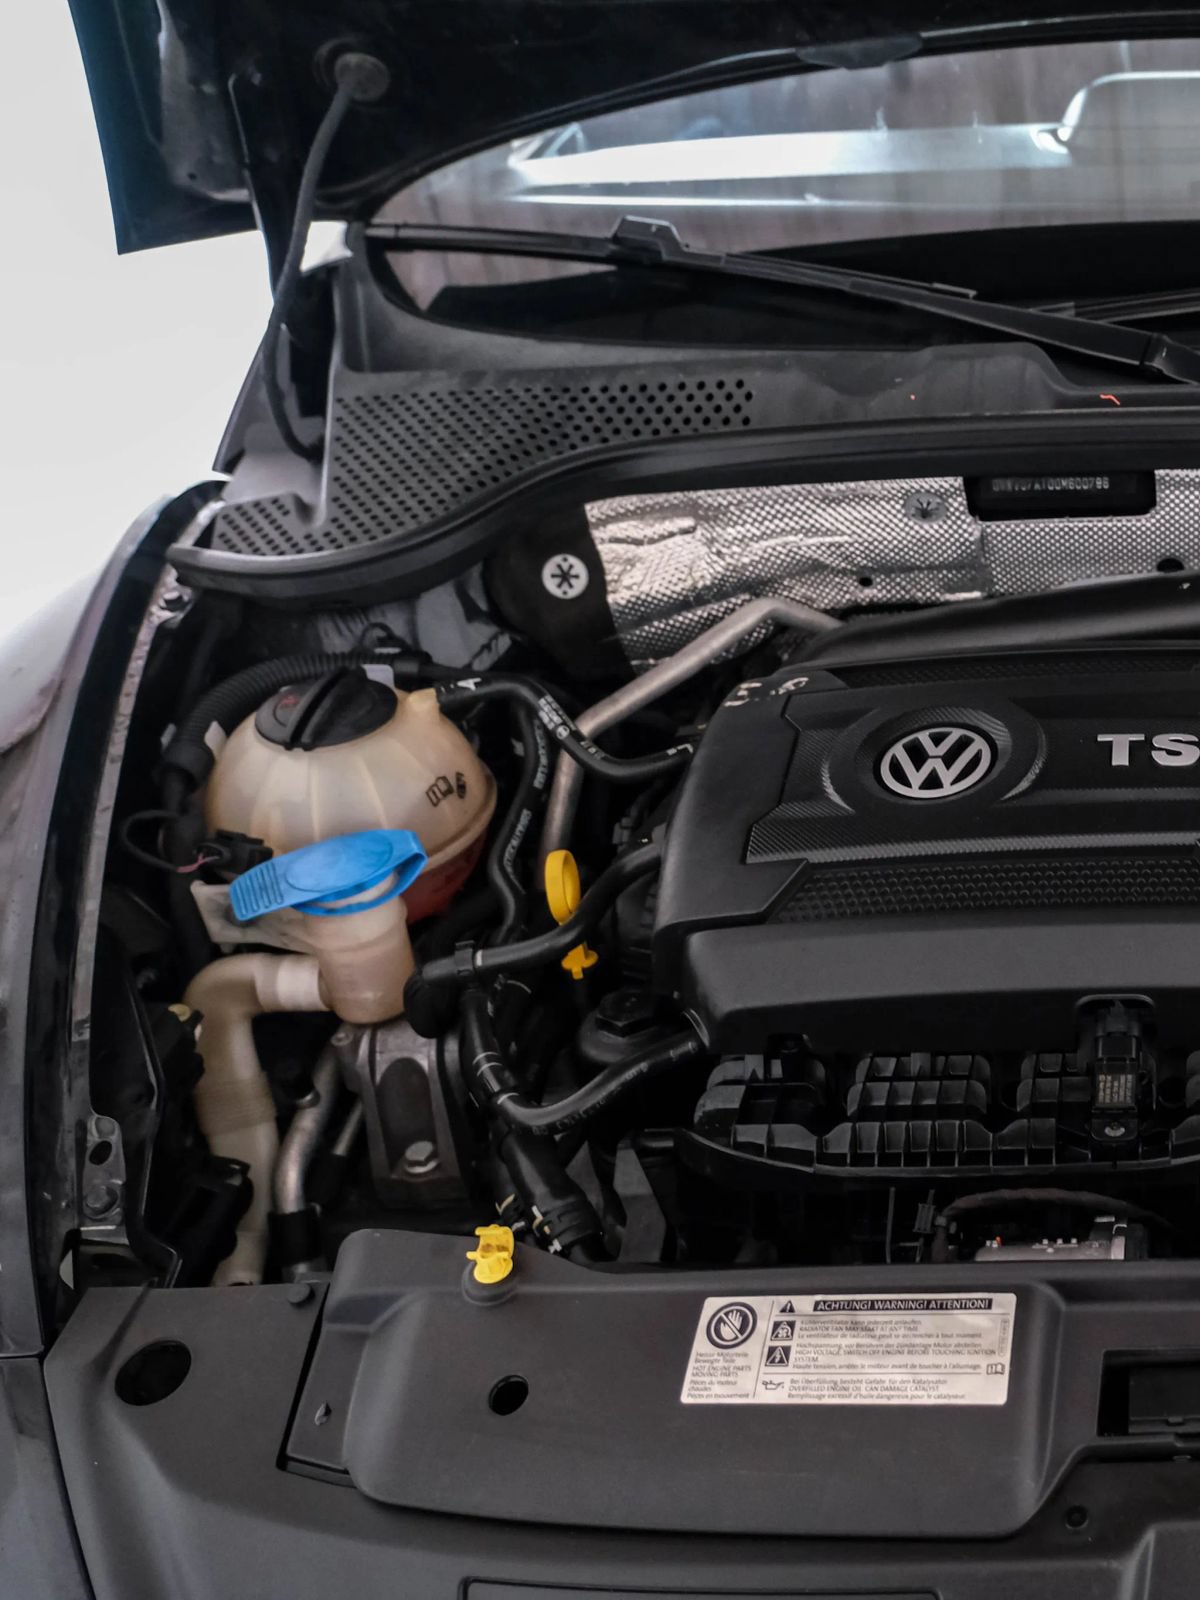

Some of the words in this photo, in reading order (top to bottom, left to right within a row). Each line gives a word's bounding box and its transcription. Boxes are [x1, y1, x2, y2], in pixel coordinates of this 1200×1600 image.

[880, 727, 992, 799] VW
[817, 1300, 871, 1310] ACHTUNG!
[874, 1300, 927, 1310] WARNING!
[929, 1299, 989, 1309] ATTENTION!
